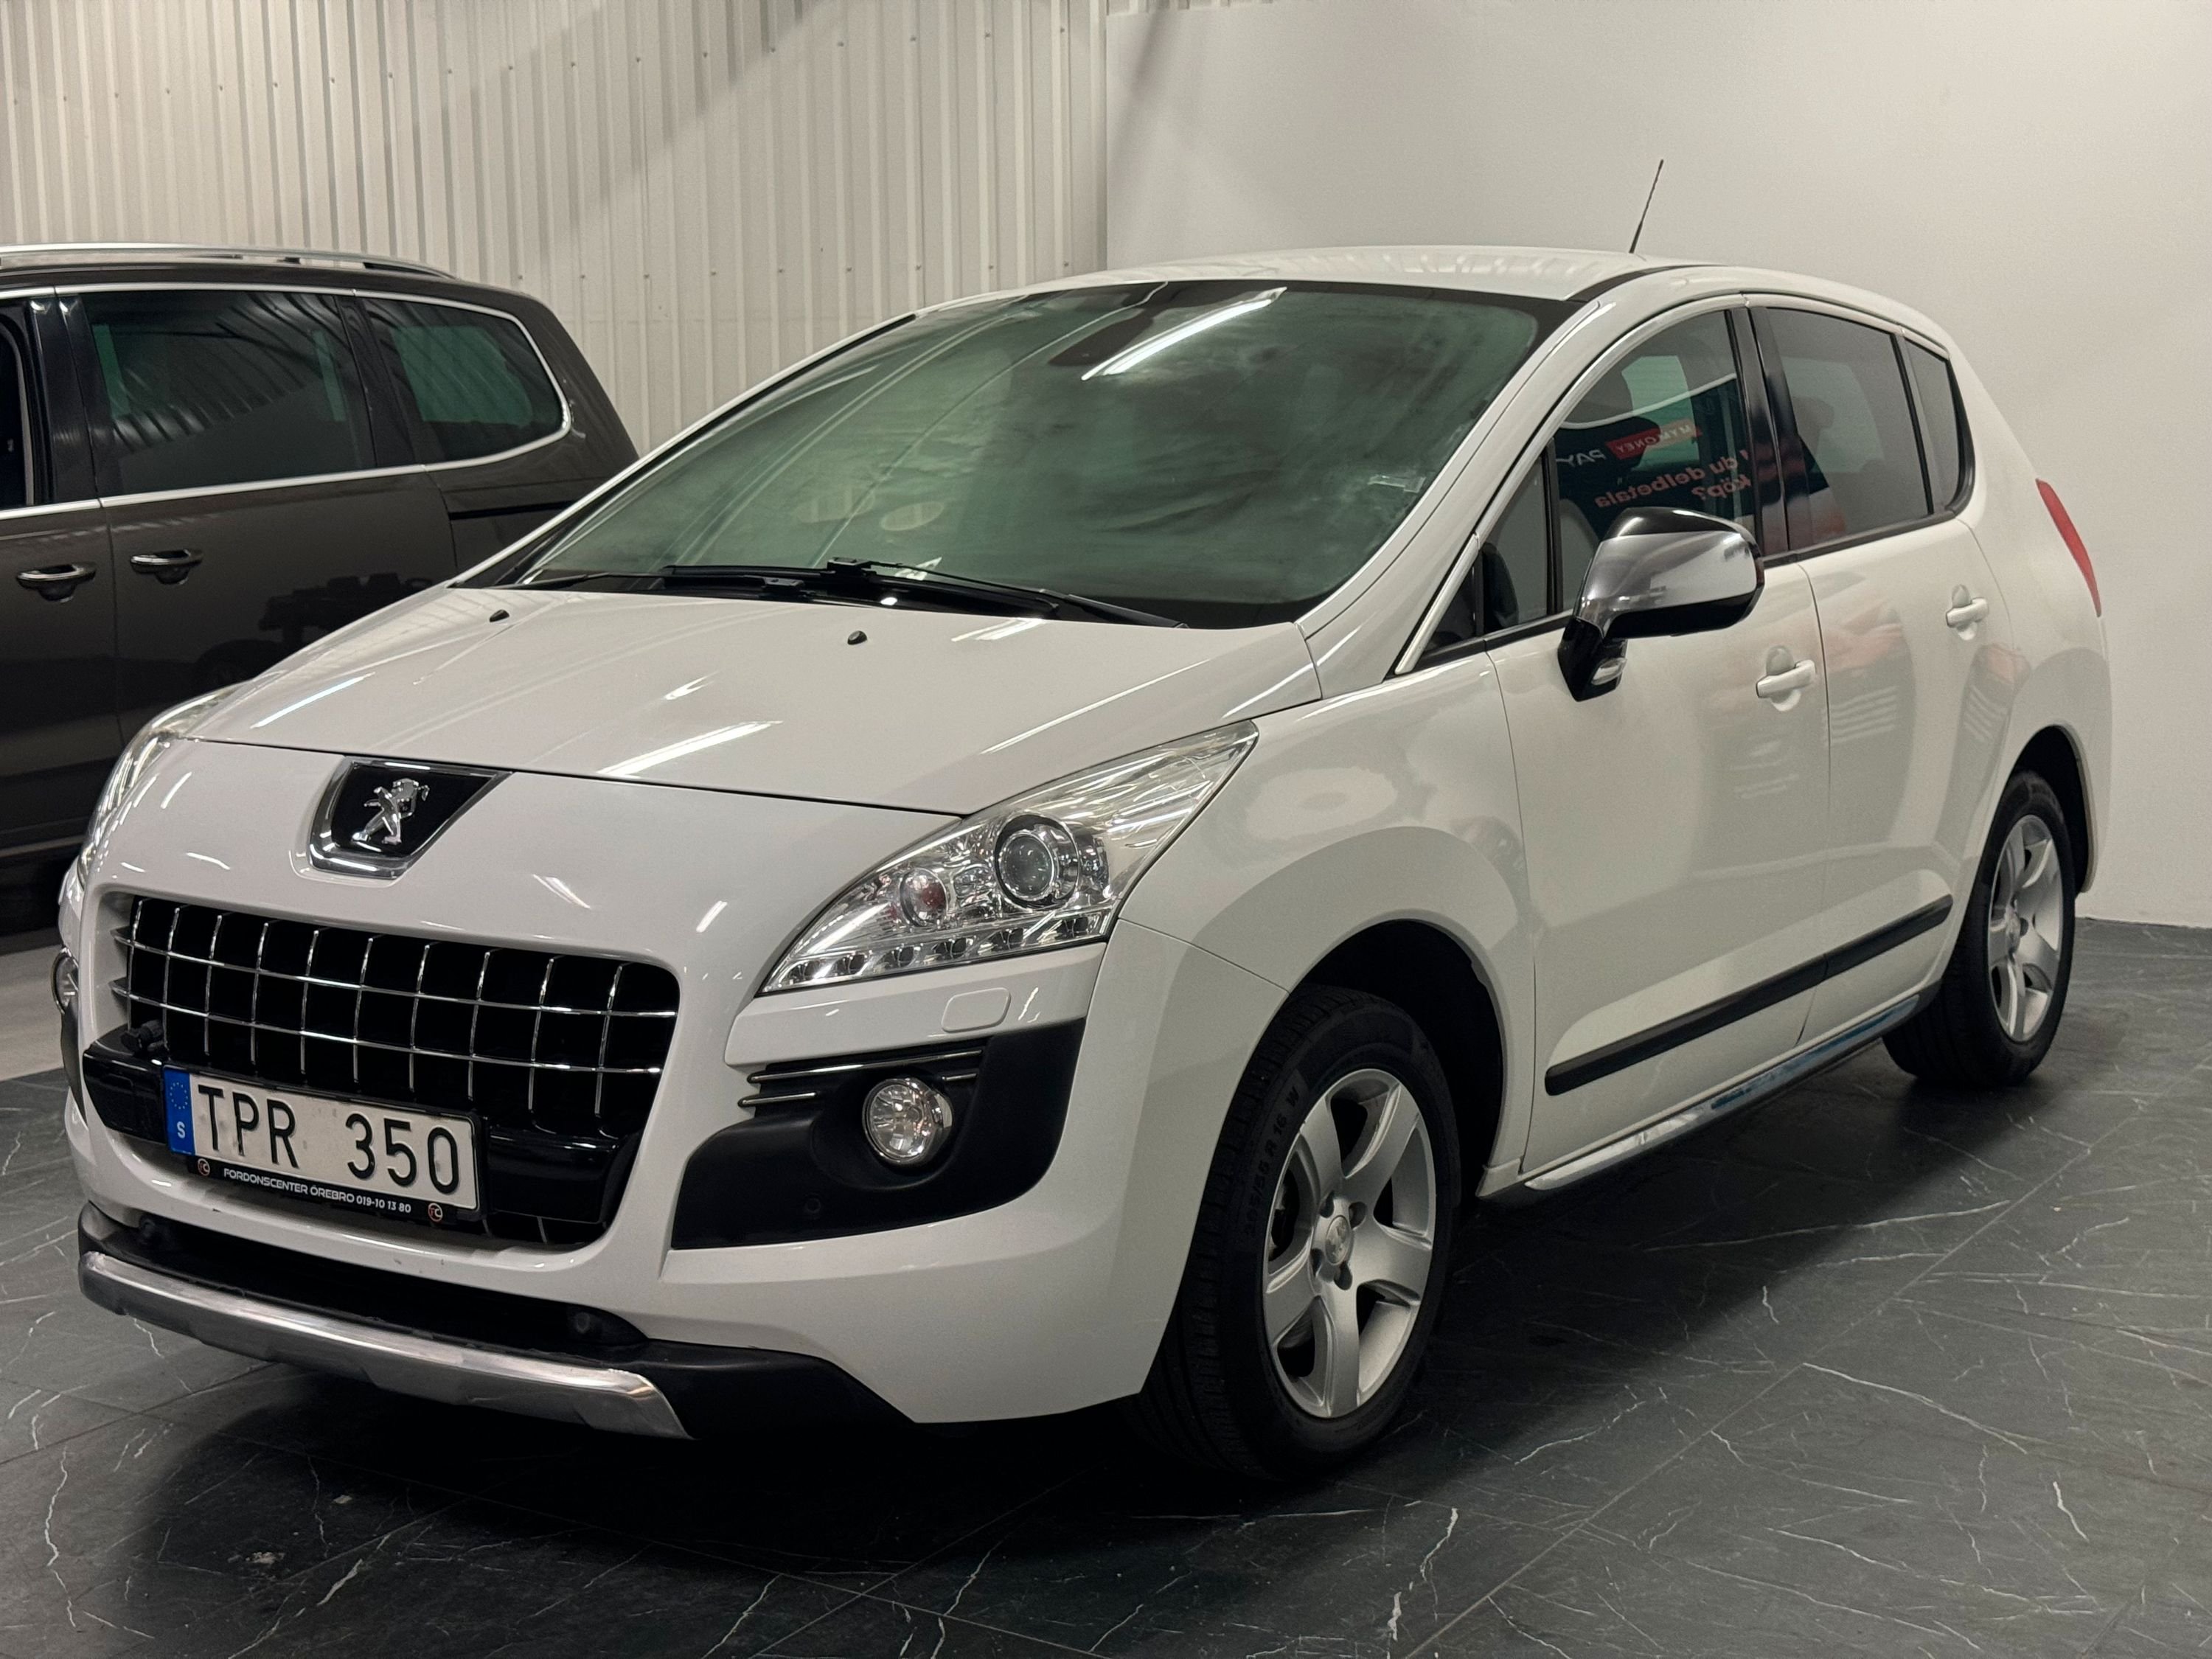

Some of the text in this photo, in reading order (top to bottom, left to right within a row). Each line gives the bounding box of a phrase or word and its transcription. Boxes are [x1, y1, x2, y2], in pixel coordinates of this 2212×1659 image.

[176, 1121, 186, 1139] S
[197, 1083, 460, 1194] TPR 350
[1264, 1139, 1277, 1158] R
[1273, 1113, 1287, 1135] 16
[1285, 1085, 1299, 1107] W
[223, 1167, 411, 1214] FORDONSCENTER ÖREBRO 019-10 13 80
